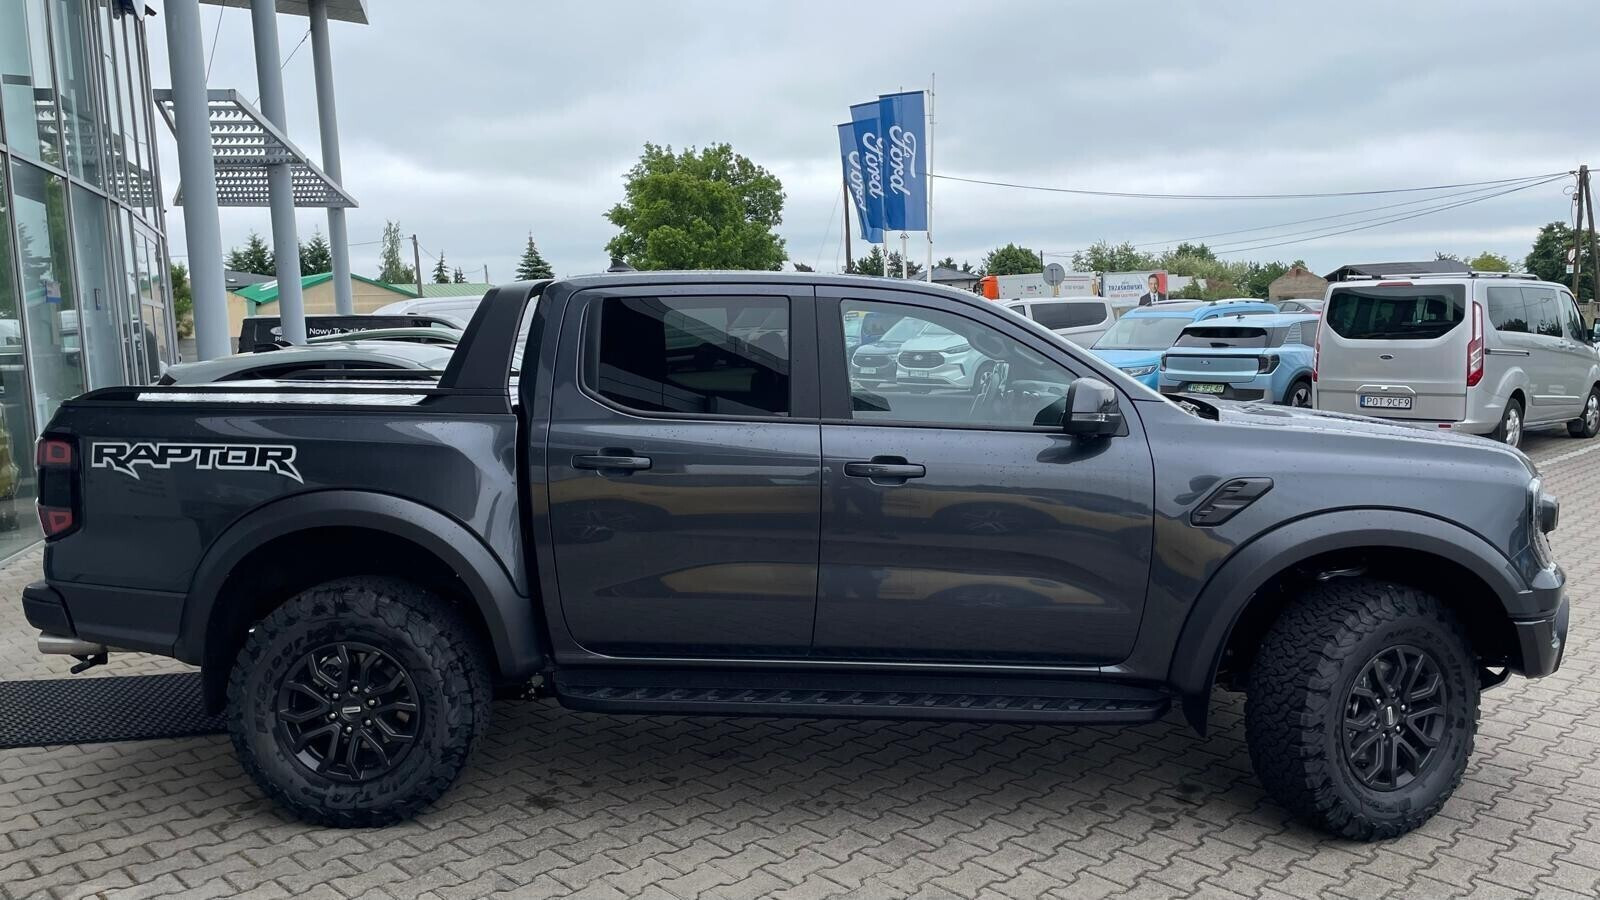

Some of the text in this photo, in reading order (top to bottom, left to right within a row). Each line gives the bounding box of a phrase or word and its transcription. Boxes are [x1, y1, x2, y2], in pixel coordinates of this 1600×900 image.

[862, 132, 884, 199] Ford
[889, 125, 917, 195] Ford
[1366, 397, 1410, 407] POT 9CF9
[91, 442, 304, 485] RAPTOR
